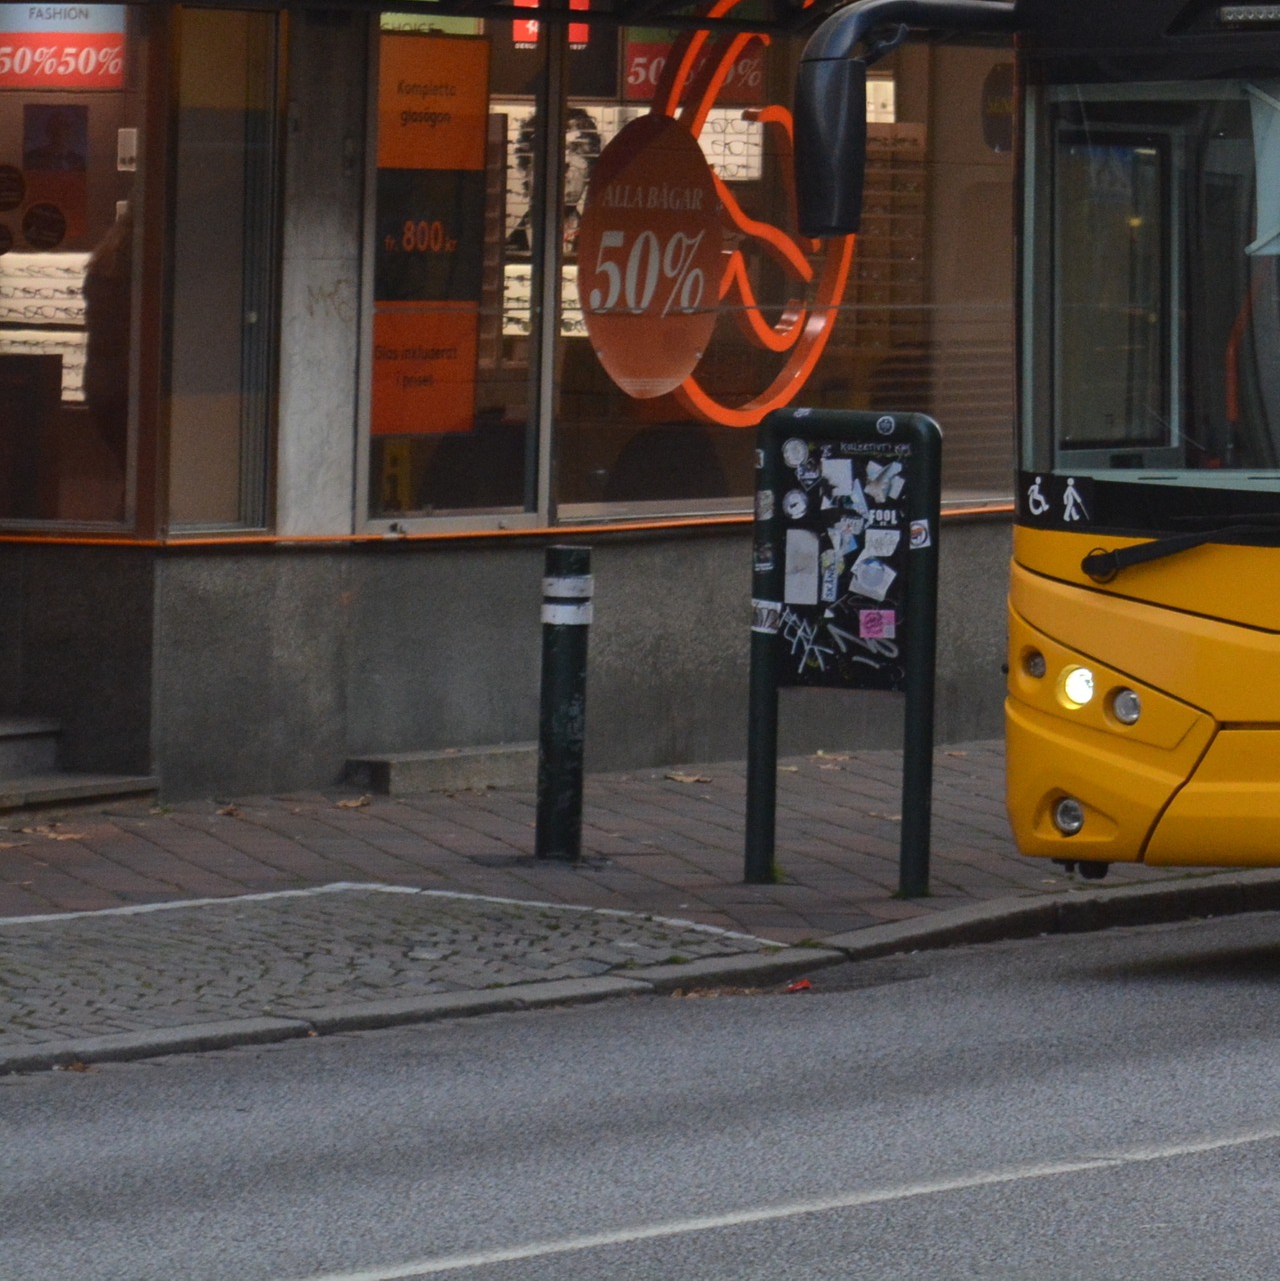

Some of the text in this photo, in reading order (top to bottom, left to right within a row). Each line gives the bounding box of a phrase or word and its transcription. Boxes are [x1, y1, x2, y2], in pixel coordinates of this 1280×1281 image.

[28, 7, 88, 20] FASHION
[602, 182, 705, 210] ALLA BÅGAR
[402, 219, 444, 253] 800
[589, 229, 706, 319] 50%
[868, 509, 898, 525] FOOL
